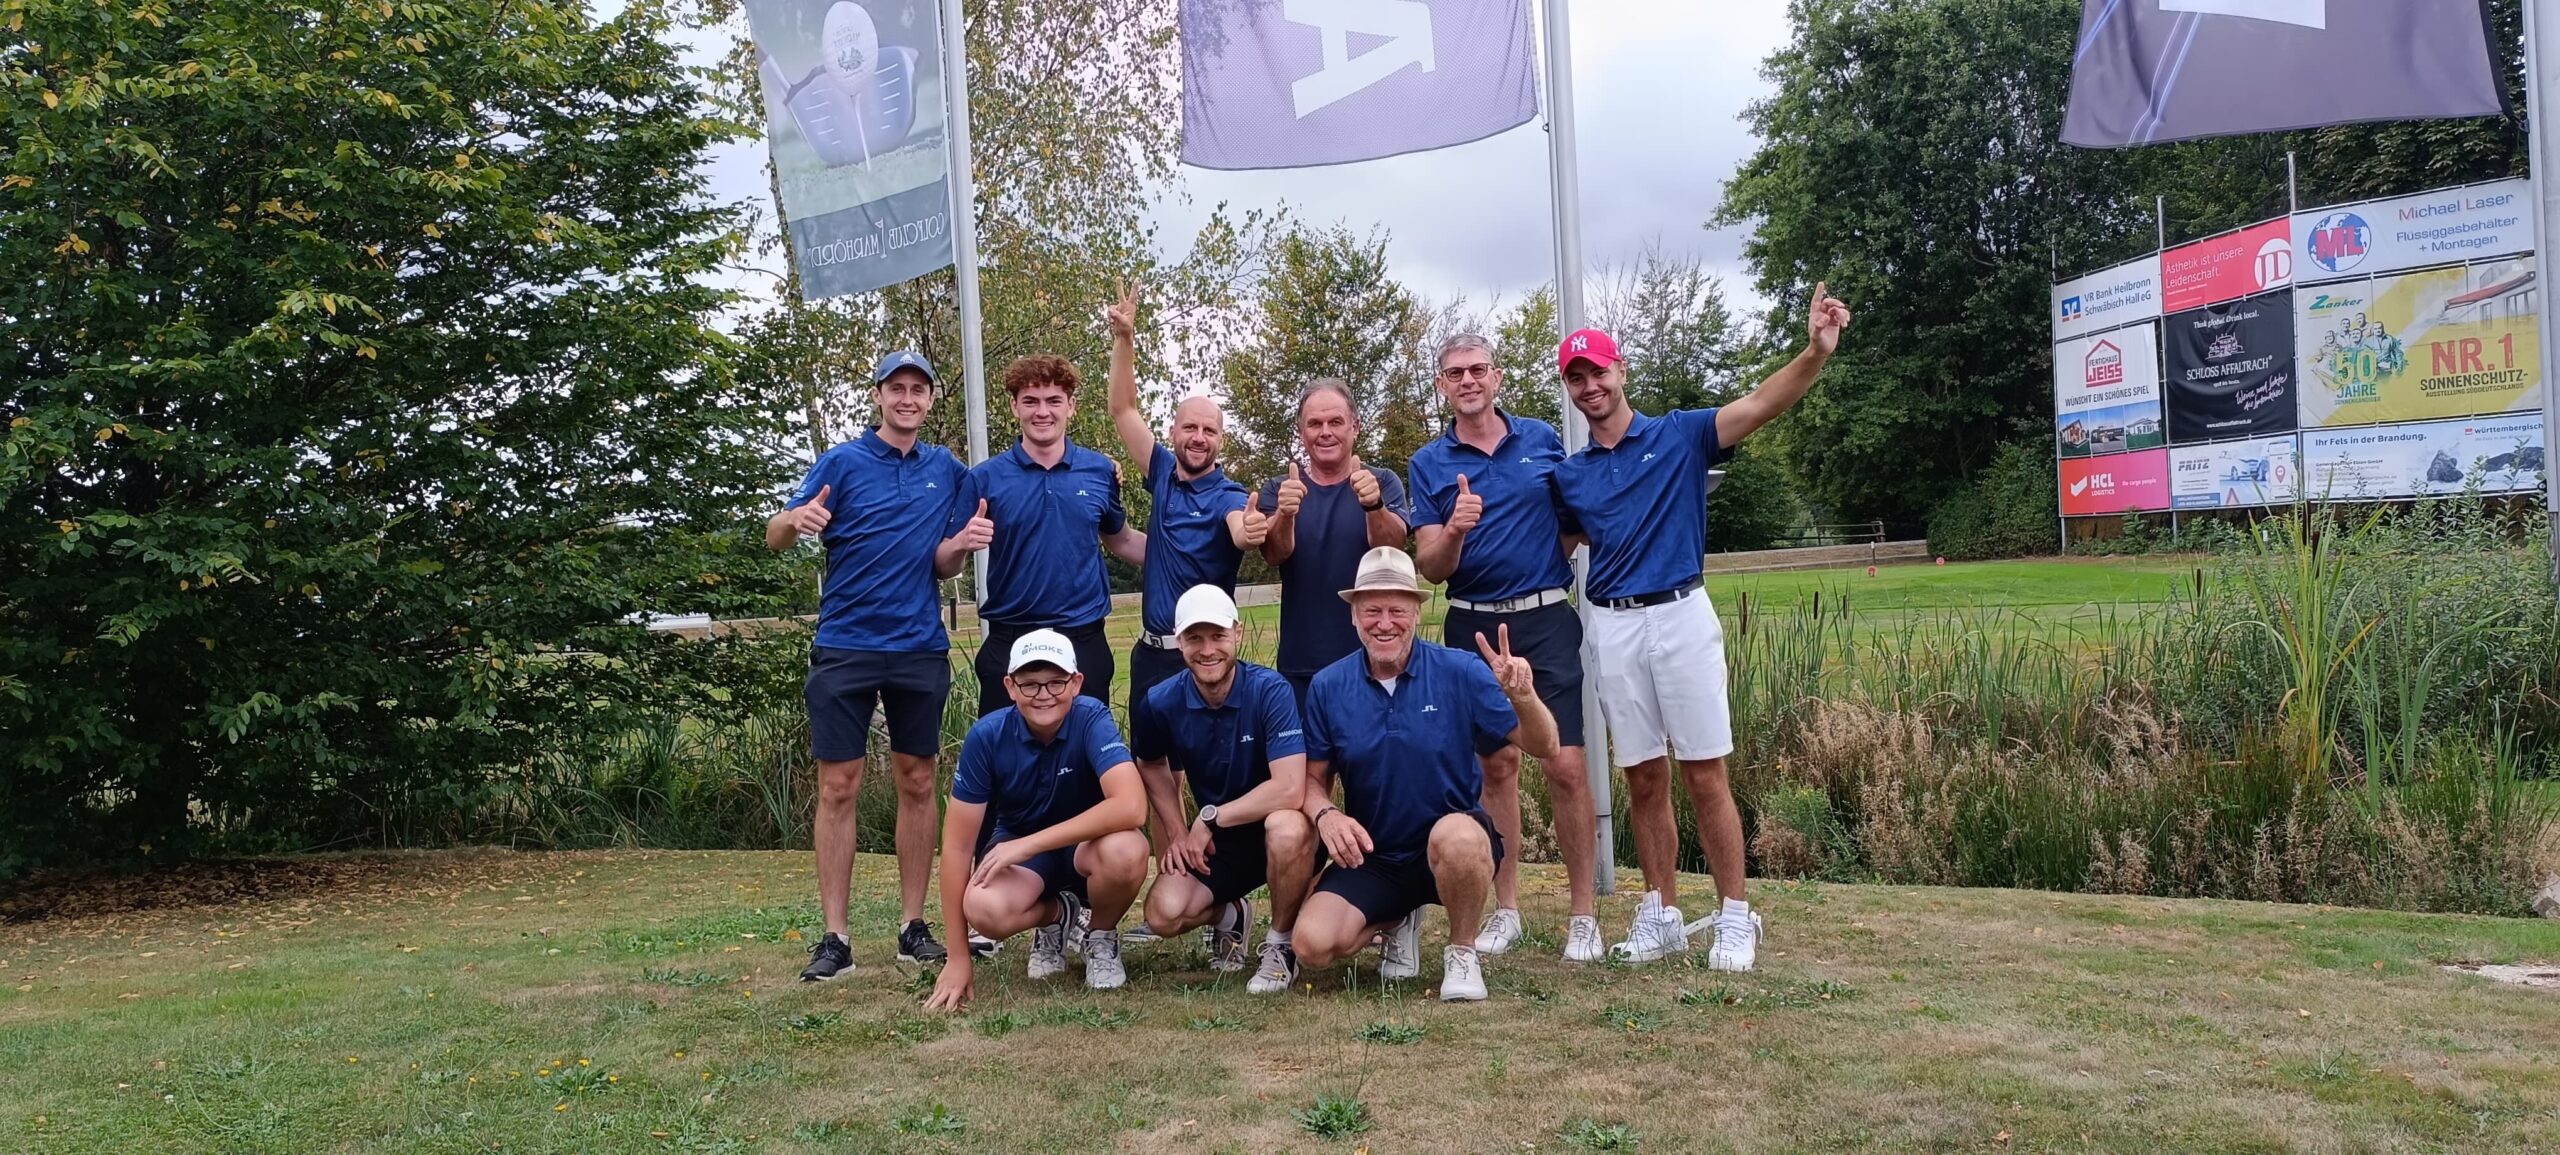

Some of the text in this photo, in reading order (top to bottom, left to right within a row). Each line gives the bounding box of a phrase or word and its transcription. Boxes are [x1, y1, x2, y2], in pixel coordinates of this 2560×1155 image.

[2399, 194, 2514, 221] Michael Laser
[2396, 216, 2518, 242] Flüssiggasbehälter
[2431, 234, 2498, 252] Montagen
[2166, 247, 2244, 274] Ästhetik ist unsere
[2084, 292, 2094, 302] VR
[2096, 287, 2113, 300] Bank
[2115, 278, 2151, 297] Heilbronn
[2085, 290, 2151, 316] Schwäbisch Hall eG
[2309, 295, 2363, 310] Zanker
[1571, 335, 1587, 352] NY
[2089, 355, 2118, 367] FERTIGHAUS
[2186, 365, 2219, 381] SCHLOSS
[2065, 385, 2149, 407] WÜNSCHT EIN SCHÖNES SPIEL
[2337, 383, 2377, 398] JAHRE
[2330, 437, 2348, 445] Fels
[2350, 436, 2359, 444] in
[2361, 435, 2376, 443] der
[2091, 473, 2115, 489] HCL
[2091, 489, 2115, 497] LOGISTICS
[1022, 645, 1063, 655] SMOKE
